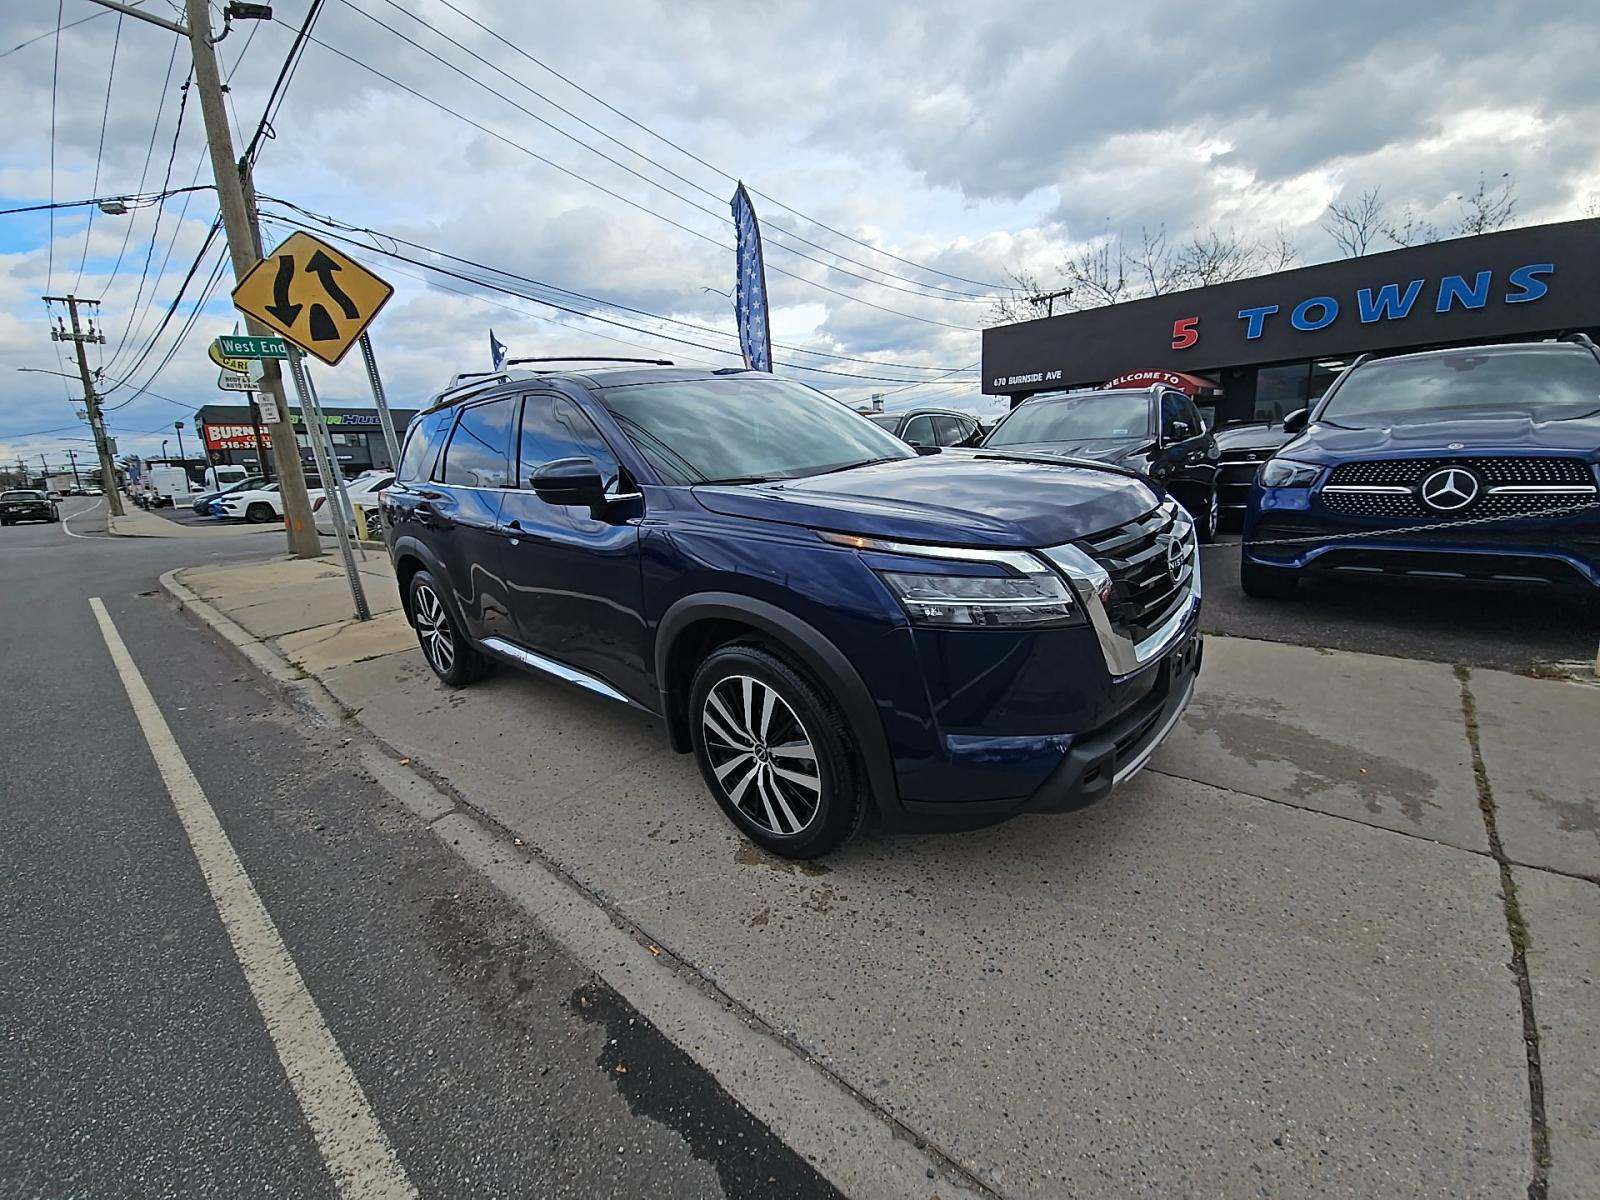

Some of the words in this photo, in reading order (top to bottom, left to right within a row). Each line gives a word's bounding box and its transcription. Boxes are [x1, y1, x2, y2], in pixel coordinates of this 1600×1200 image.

[1171, 316, 1200, 350] 5
[1237, 263, 1555, 340] TOWNS
[222, 339, 256, 353] West
[260, 341, 287, 353] End
[993, 376, 1007, 387] 670
[1008, 371, 1043, 385] BURNSIDE
[1045, 370, 1062, 381] AVE
[1103, 372, 1161, 390] WELCOME
[1163, 373, 1179, 384] TO
